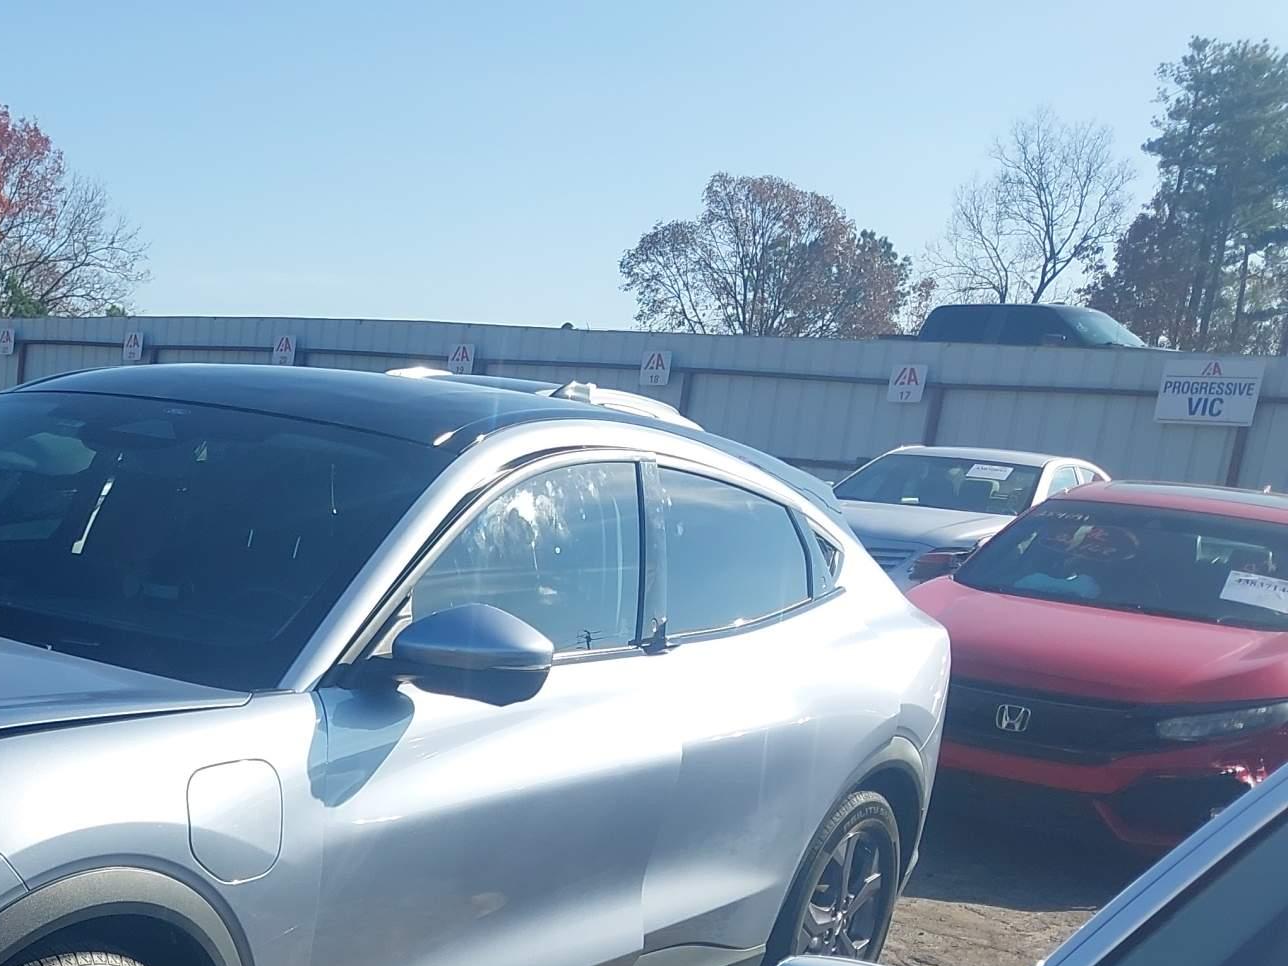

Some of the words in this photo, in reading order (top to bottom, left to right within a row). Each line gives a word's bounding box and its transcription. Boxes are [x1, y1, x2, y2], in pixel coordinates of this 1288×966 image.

[898, 391, 912, 401] 17
[1163, 380, 1256, 396] PROGRESSIVE
[1187, 396, 1225, 418] VIC
